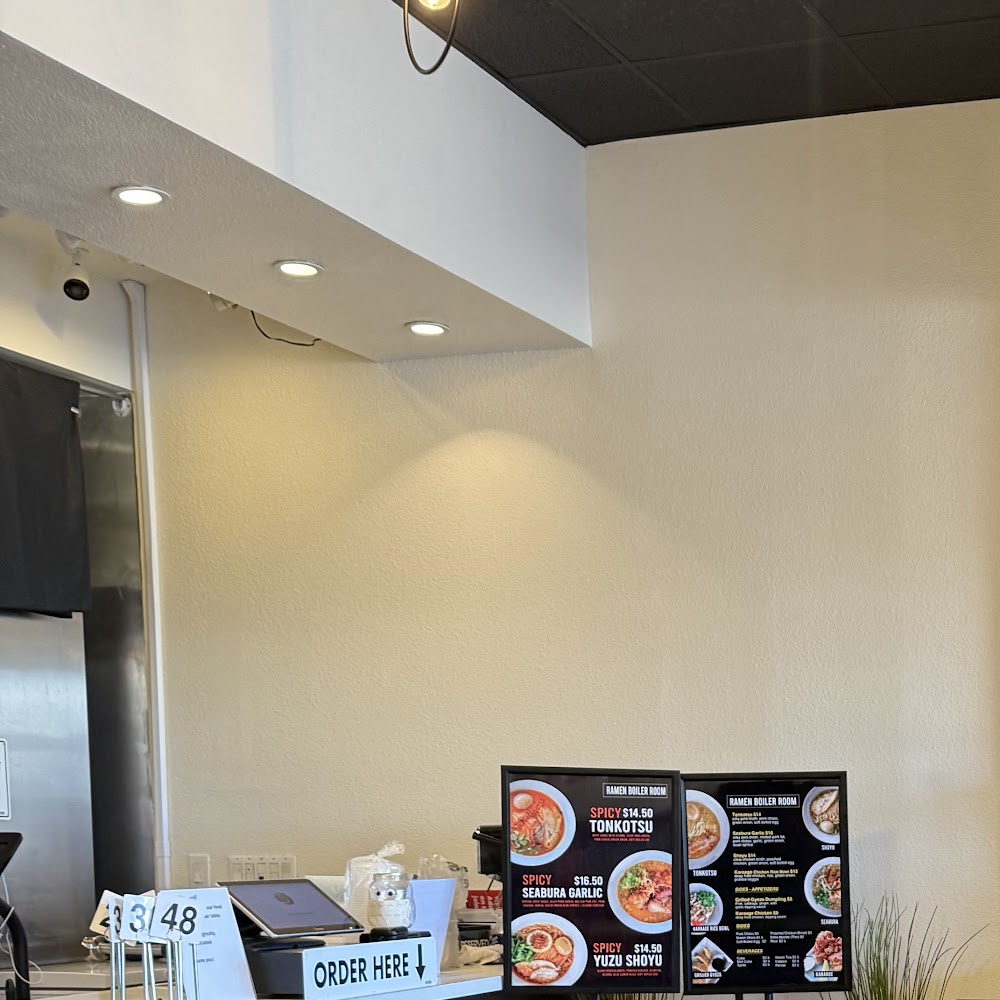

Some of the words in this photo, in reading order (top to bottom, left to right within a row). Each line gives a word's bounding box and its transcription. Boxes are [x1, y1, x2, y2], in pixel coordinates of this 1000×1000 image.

[606, 786, 627, 795] RAMEN
[628, 786, 648, 795] BOILER
[649, 786, 666, 796] ROOM
[729, 797, 753, 806] RAMEN
[754, 797, 777, 806] BOILER
[778, 796, 797, 805] ROOM
[590, 807, 621, 818] SPICY
[622, 807, 653, 818] $14.50
[589, 820, 653, 833] TONKOTSU
[522, 874, 552, 886] SPICY
[574, 876, 603, 886] $16.50
[522, 887, 566, 898] SEABURA
[568, 887, 603, 899] GARLIC
[161, 903, 197, 935] 48
[593, 943, 621, 953] SPICY
[634, 943, 662, 953] $14.50
[593, 954, 622, 967] YUZU
[626, 954, 662, 967] SHOYU
[314, 957, 368, 988] ORDER
[373, 953, 409, 980] HERE
